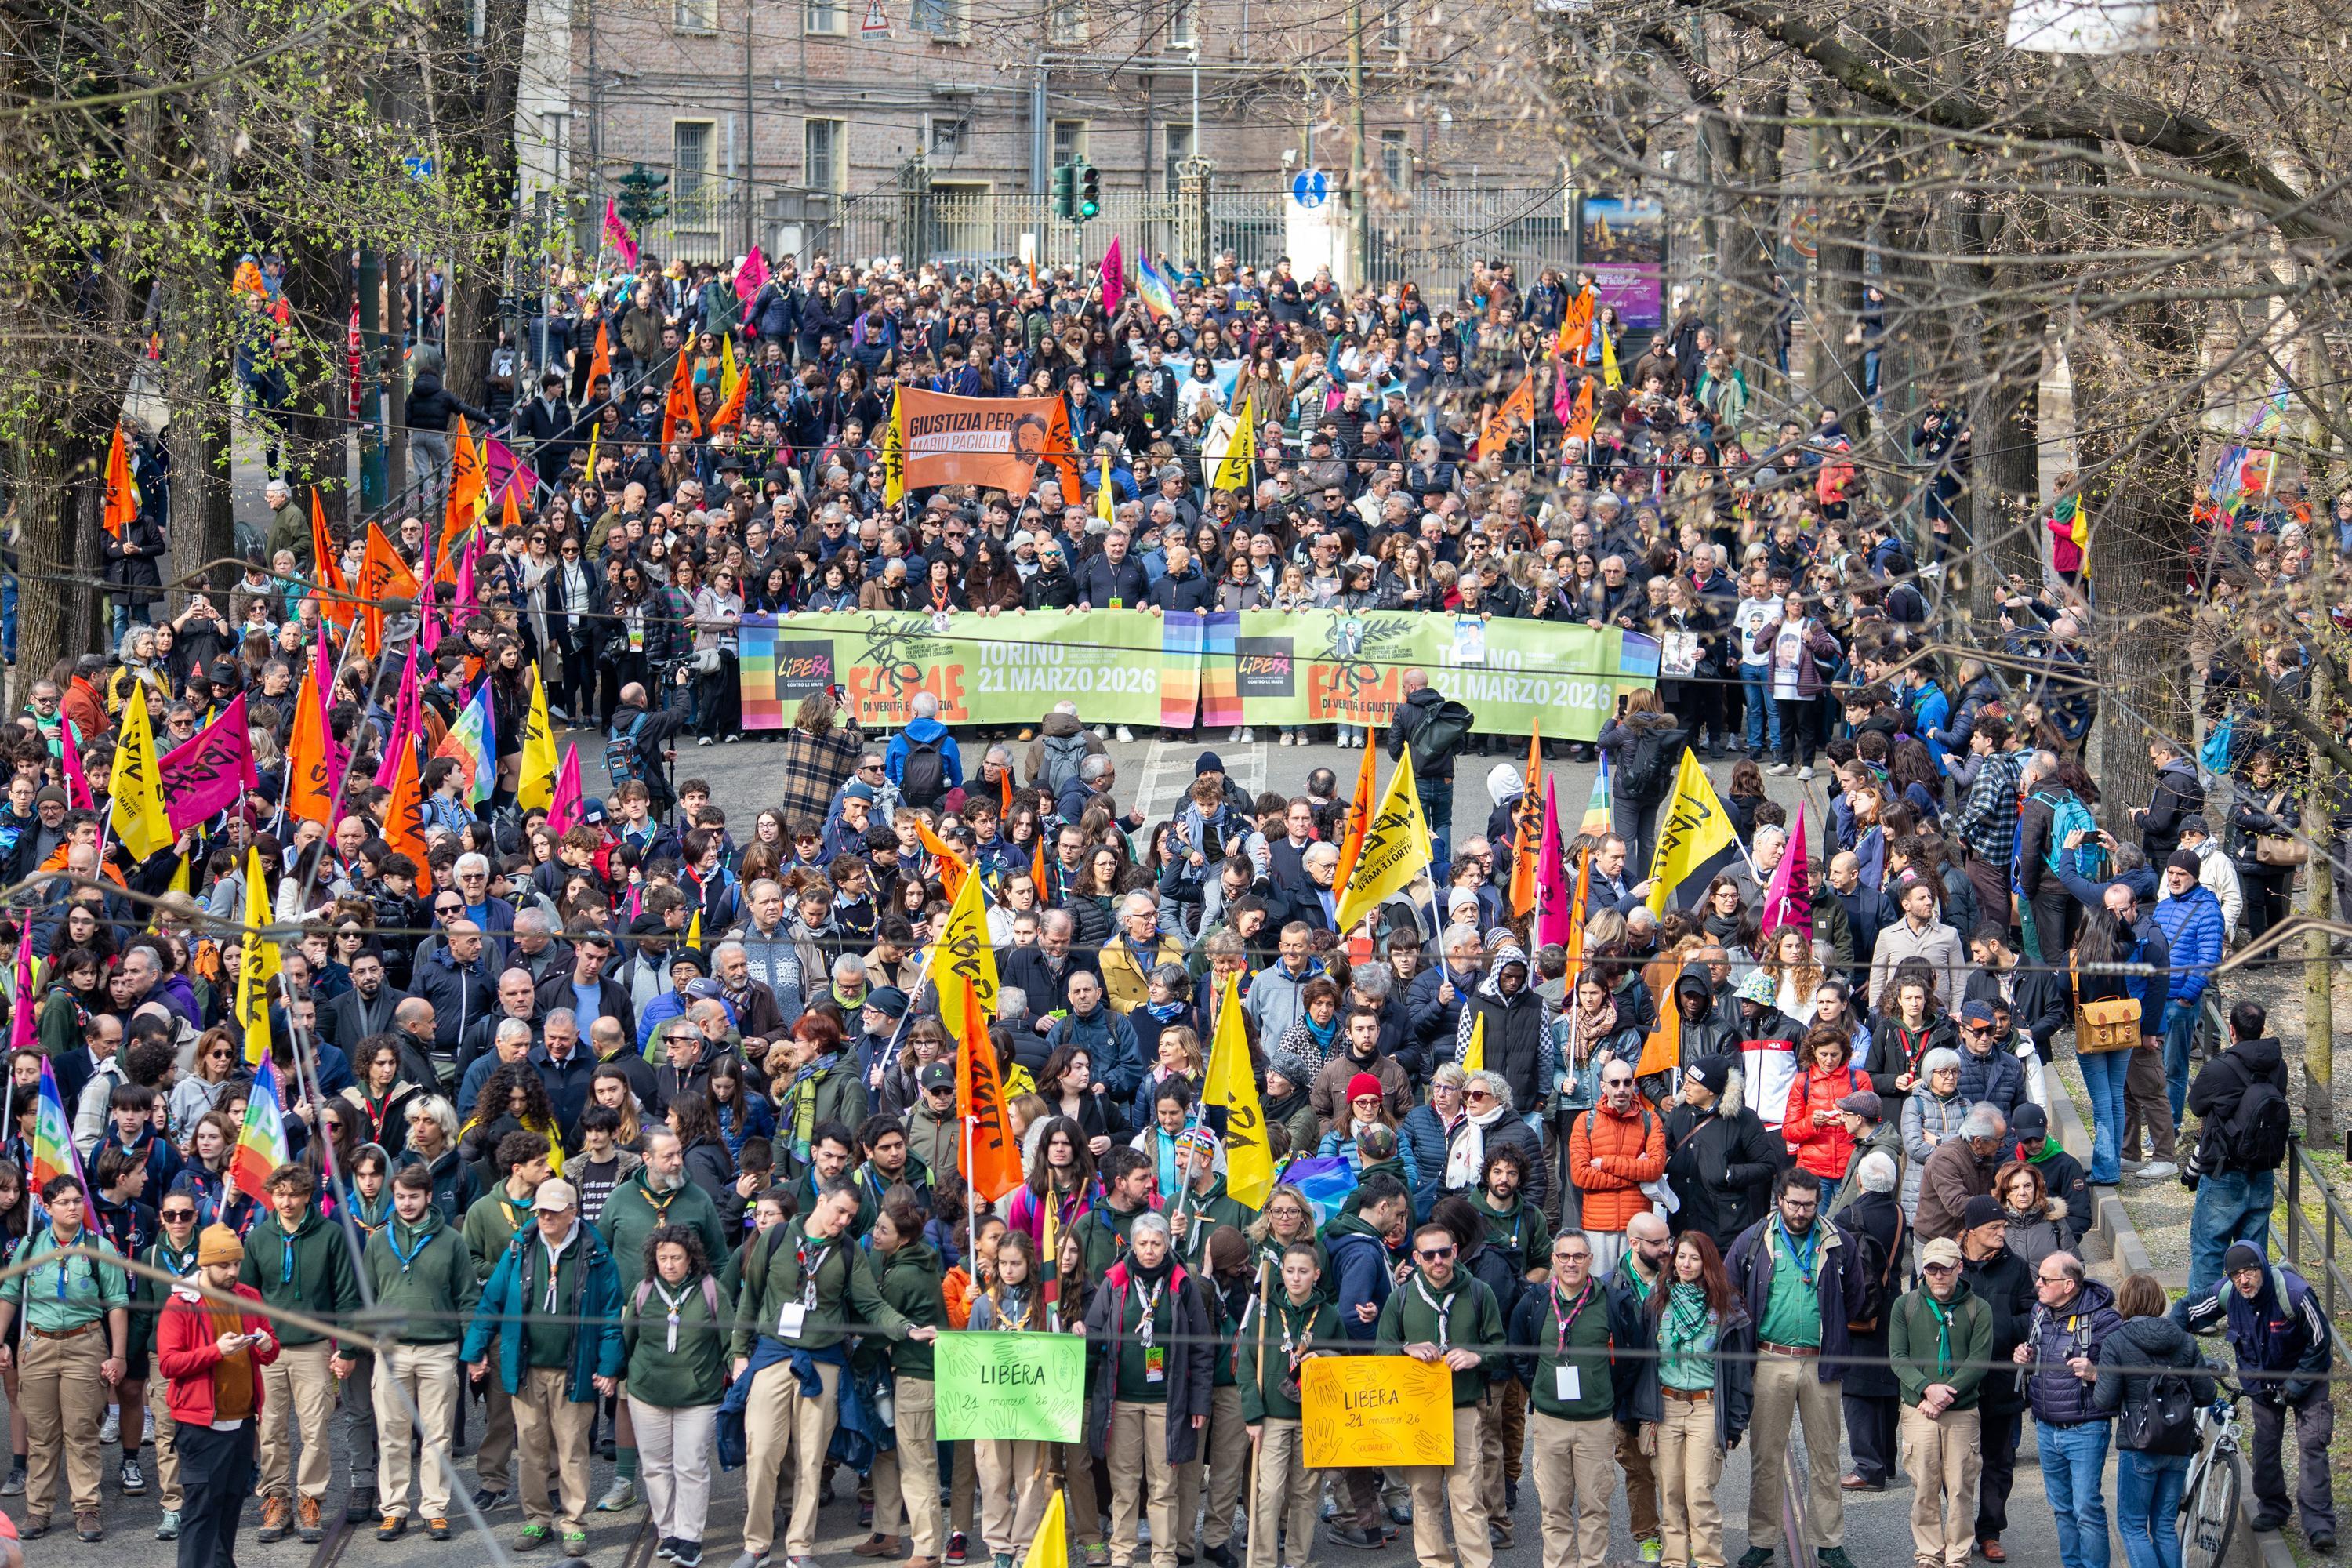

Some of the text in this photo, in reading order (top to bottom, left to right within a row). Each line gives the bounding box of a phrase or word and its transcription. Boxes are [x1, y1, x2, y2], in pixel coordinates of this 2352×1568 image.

[909, 412, 1014, 438] GIUSTIZIA PER
[912, 432, 1007, 458] MARIO PACIOLLA
[977, 640, 1065, 666] TORINO
[978, 667, 1156, 694] 21 MARZO 2026
[1437, 672, 1612, 710] 21 MARZO 2026
[848, 663, 969, 723] FAME
[863, 698, 910, 713] DI VERITÀ E
[1323, 698, 1331, 710] DI
[1333, 698, 1359, 712] VERITÀ
[1360, 701, 1366, 712] E
[118, 796, 136, 818] MAFIE
[981, 1363, 1046, 1385] LIBERA
[962, 1394, 980, 1410] 21
[988, 1396, 1028, 1406] marzo
[1344, 1388, 1399, 1410] LIBERA
[1345, 1413, 1365, 1428] 21
